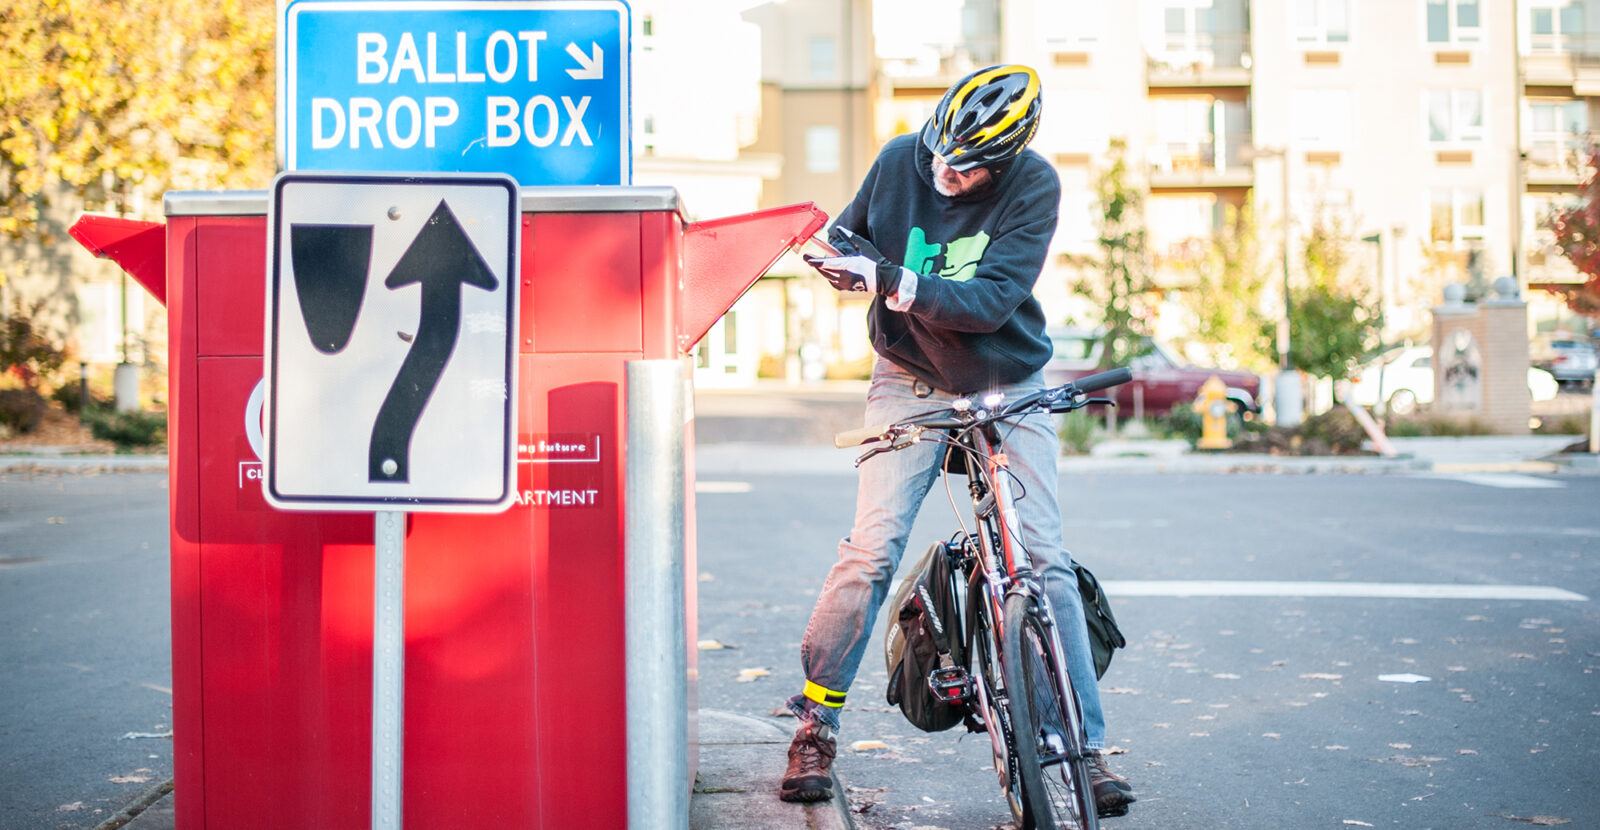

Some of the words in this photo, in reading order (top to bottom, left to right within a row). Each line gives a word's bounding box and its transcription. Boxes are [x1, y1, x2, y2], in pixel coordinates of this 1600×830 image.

[356, 30, 547, 84] BALLOT
[311, 96, 459, 149] DROP
[487, 95, 594, 147] BOX
[539, 440, 587, 453] future
